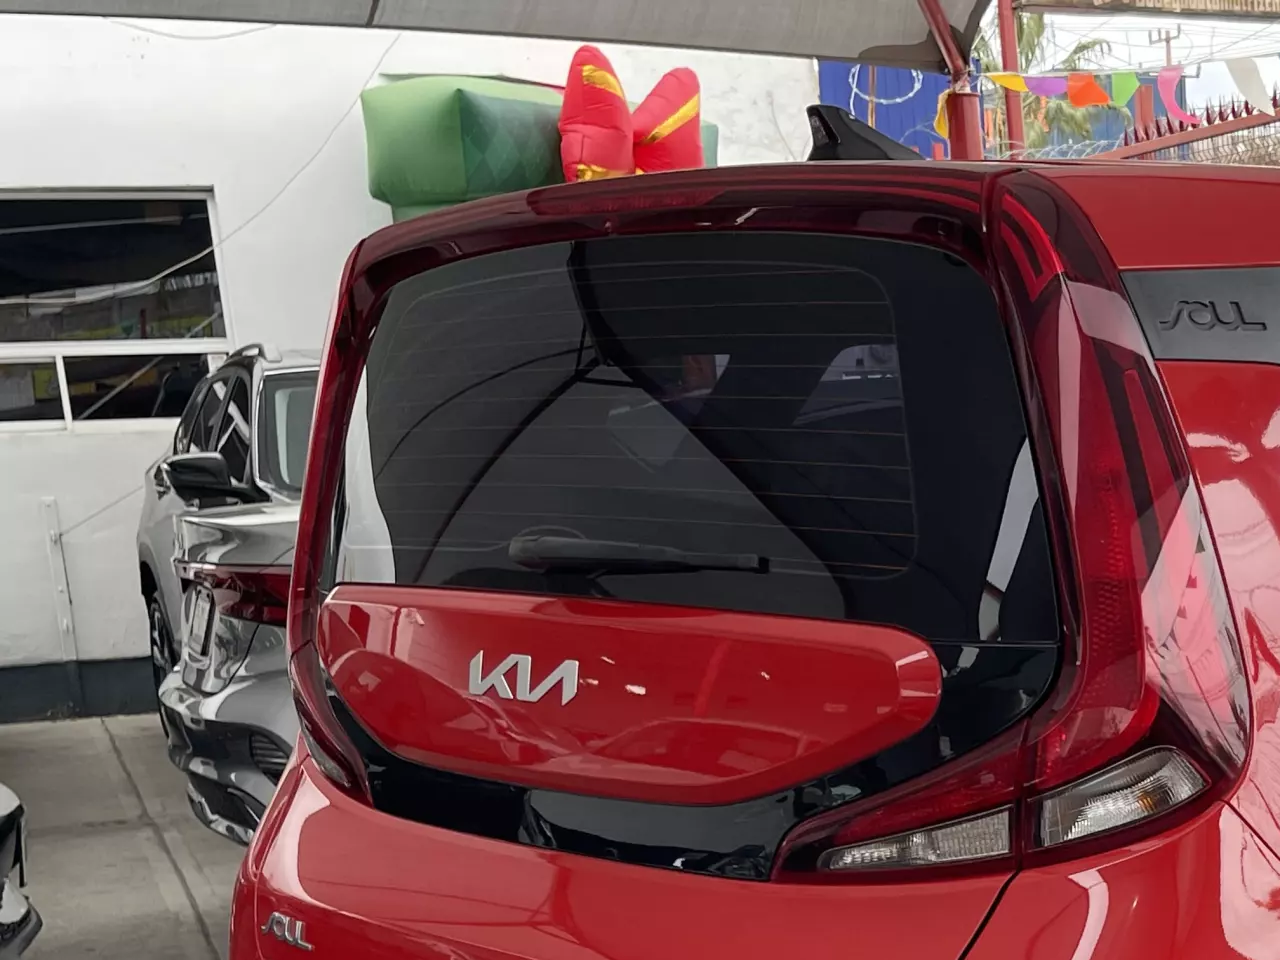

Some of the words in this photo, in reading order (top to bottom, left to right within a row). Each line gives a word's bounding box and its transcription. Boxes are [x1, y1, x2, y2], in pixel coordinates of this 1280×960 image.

[1158, 300, 1267, 331] SOUL
[469, 650, 580, 706] KIA
[261, 911, 313, 951] SOUL
